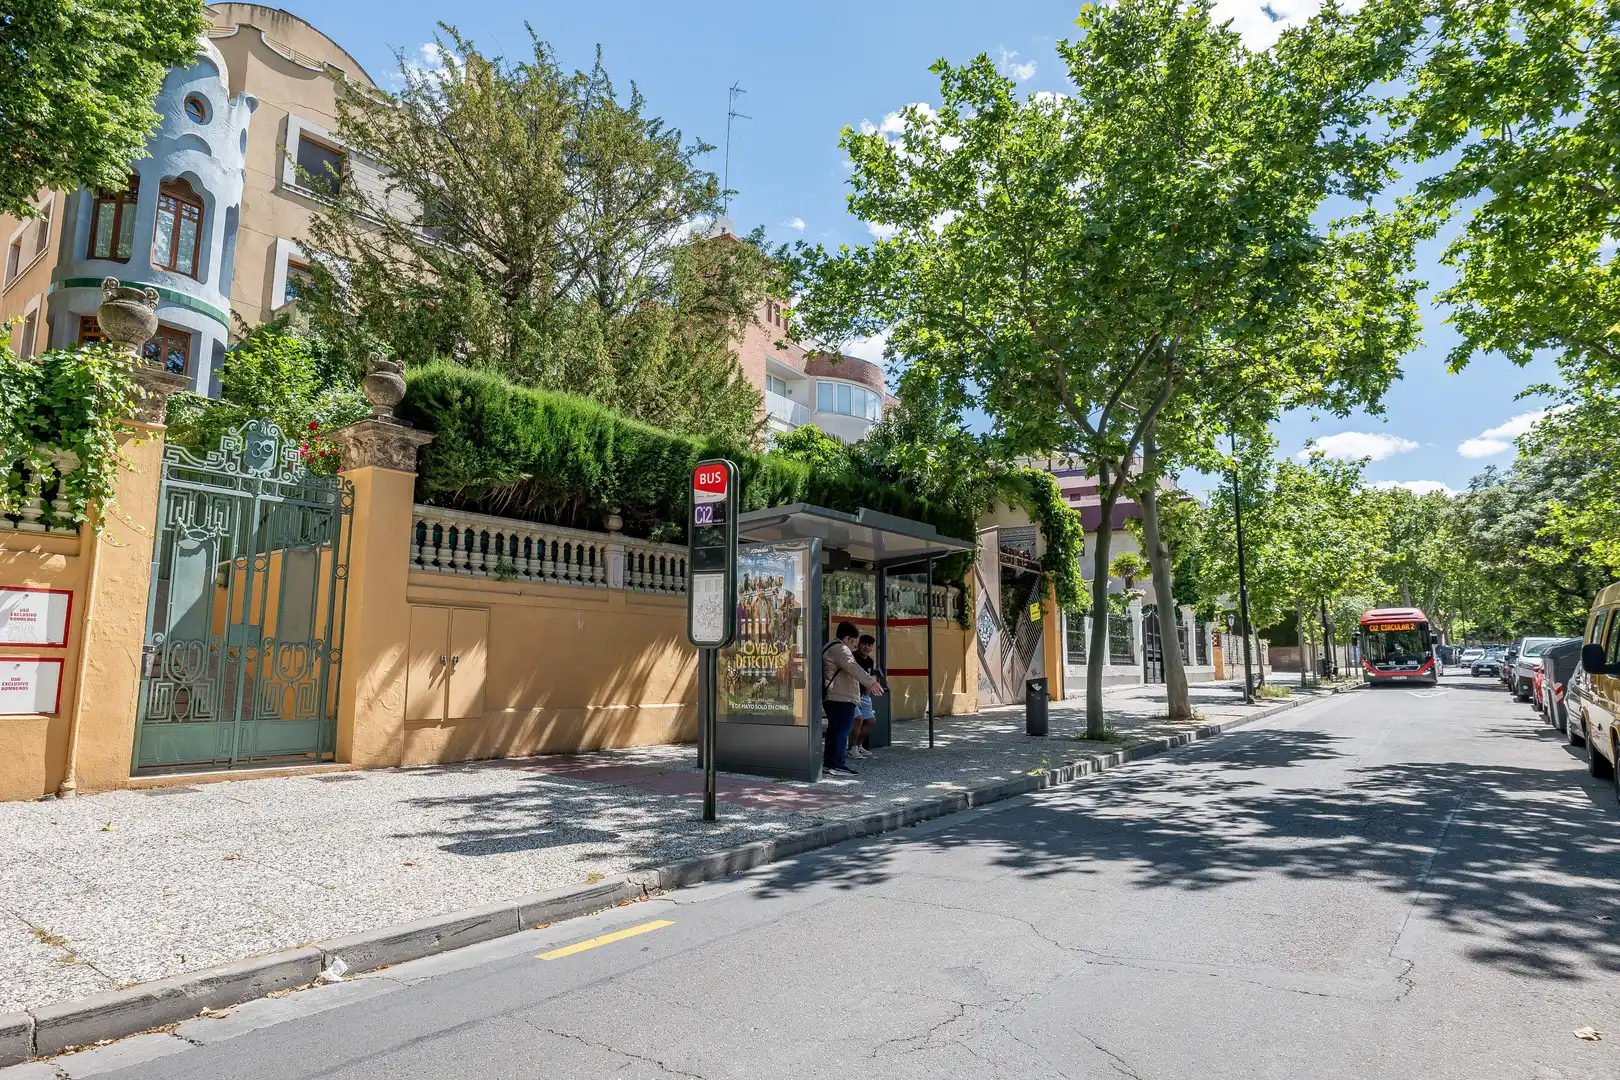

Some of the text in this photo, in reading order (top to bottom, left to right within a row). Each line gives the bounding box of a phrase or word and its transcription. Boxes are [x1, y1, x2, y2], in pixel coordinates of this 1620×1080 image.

[251, 441, 273, 459] 39
[699, 471, 721, 485] BUS
[695, 506, 713, 524] Ci2
[1380, 623, 1410, 631] CIRCULAR
[743, 640, 778, 655] OVEJAS
[736, 654, 785, 669] DETECTIVES
